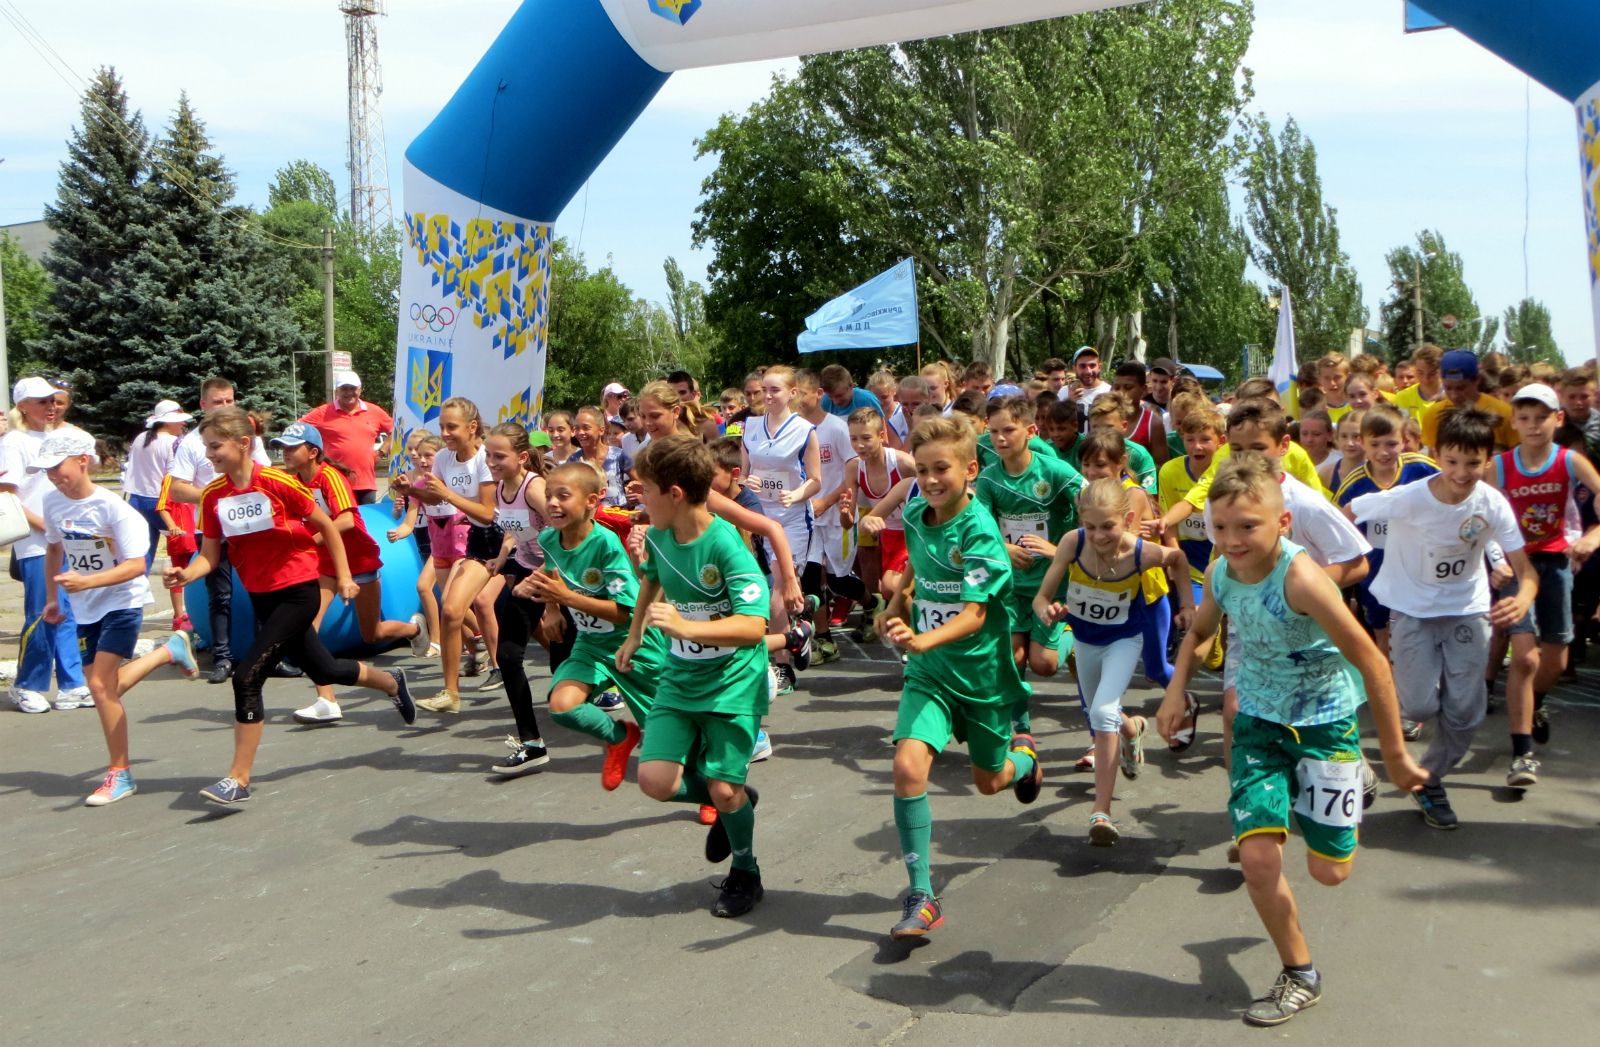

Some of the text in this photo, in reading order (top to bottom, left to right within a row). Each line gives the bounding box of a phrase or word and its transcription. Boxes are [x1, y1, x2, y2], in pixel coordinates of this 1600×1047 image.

[408, 332, 454, 345] UKRAINE
[451, 474, 472, 486] 0970
[1511, 483, 1562, 498] SOCCER
[227, 503, 263, 521] 0968
[1435, 559, 1466, 579] 90
[1075, 601, 1120, 620] 190
[1306, 785, 1356, 818] 176
